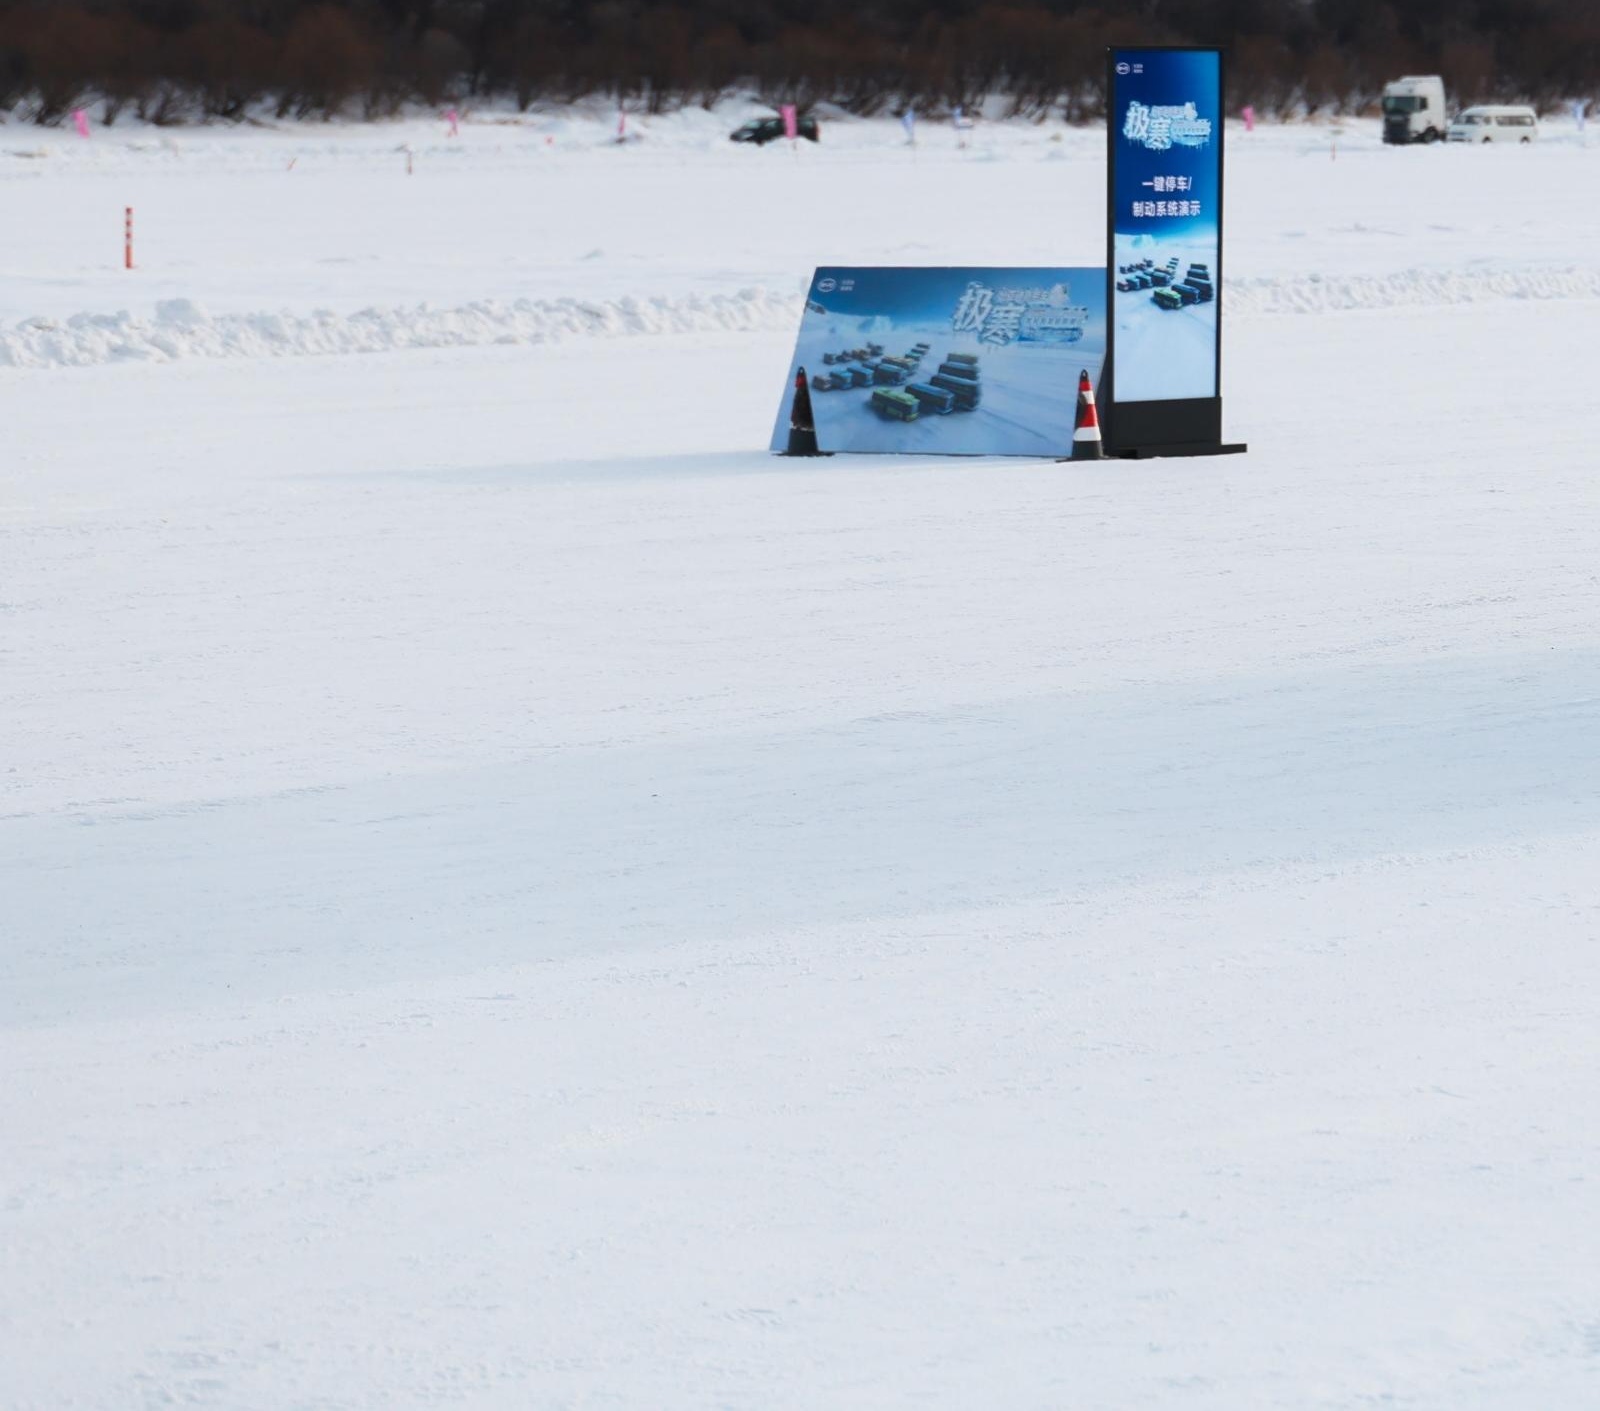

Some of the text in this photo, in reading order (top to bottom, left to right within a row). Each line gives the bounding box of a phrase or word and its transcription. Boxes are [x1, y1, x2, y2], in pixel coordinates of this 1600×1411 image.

[1132, 200, 1201, 217] 制动系统演示
